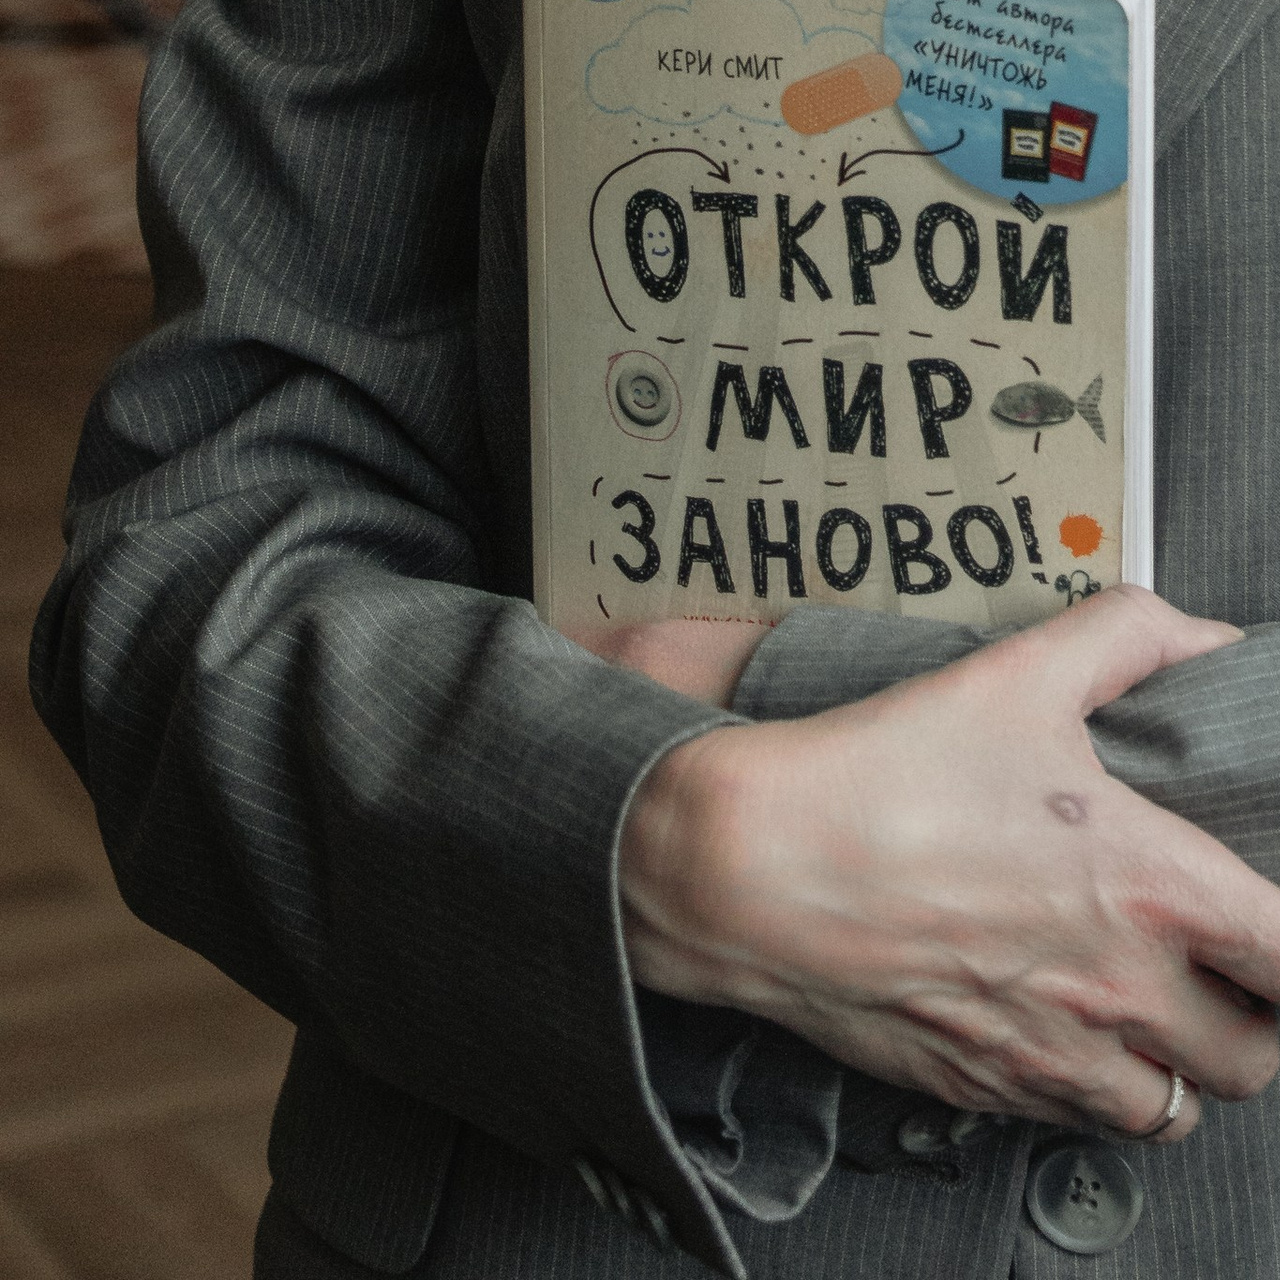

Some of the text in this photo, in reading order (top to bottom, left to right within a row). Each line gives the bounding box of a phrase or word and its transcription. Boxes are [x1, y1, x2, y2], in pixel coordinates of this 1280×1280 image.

[931, 0, 1067, 66] бестселлера
[996, 0, 1075, 39] автора
[658, 49, 712, 76] КЕРИ
[905, 69, 994, 111] МЕНЯ!»
[913, 39, 1048, 91] «УНИЧТОЖЬ
[624, 186, 1073, 325] ОТКРОЙ
[705, 358, 973, 460] МИР
[611, 489, 1049, 598] ЗАНОВО!
